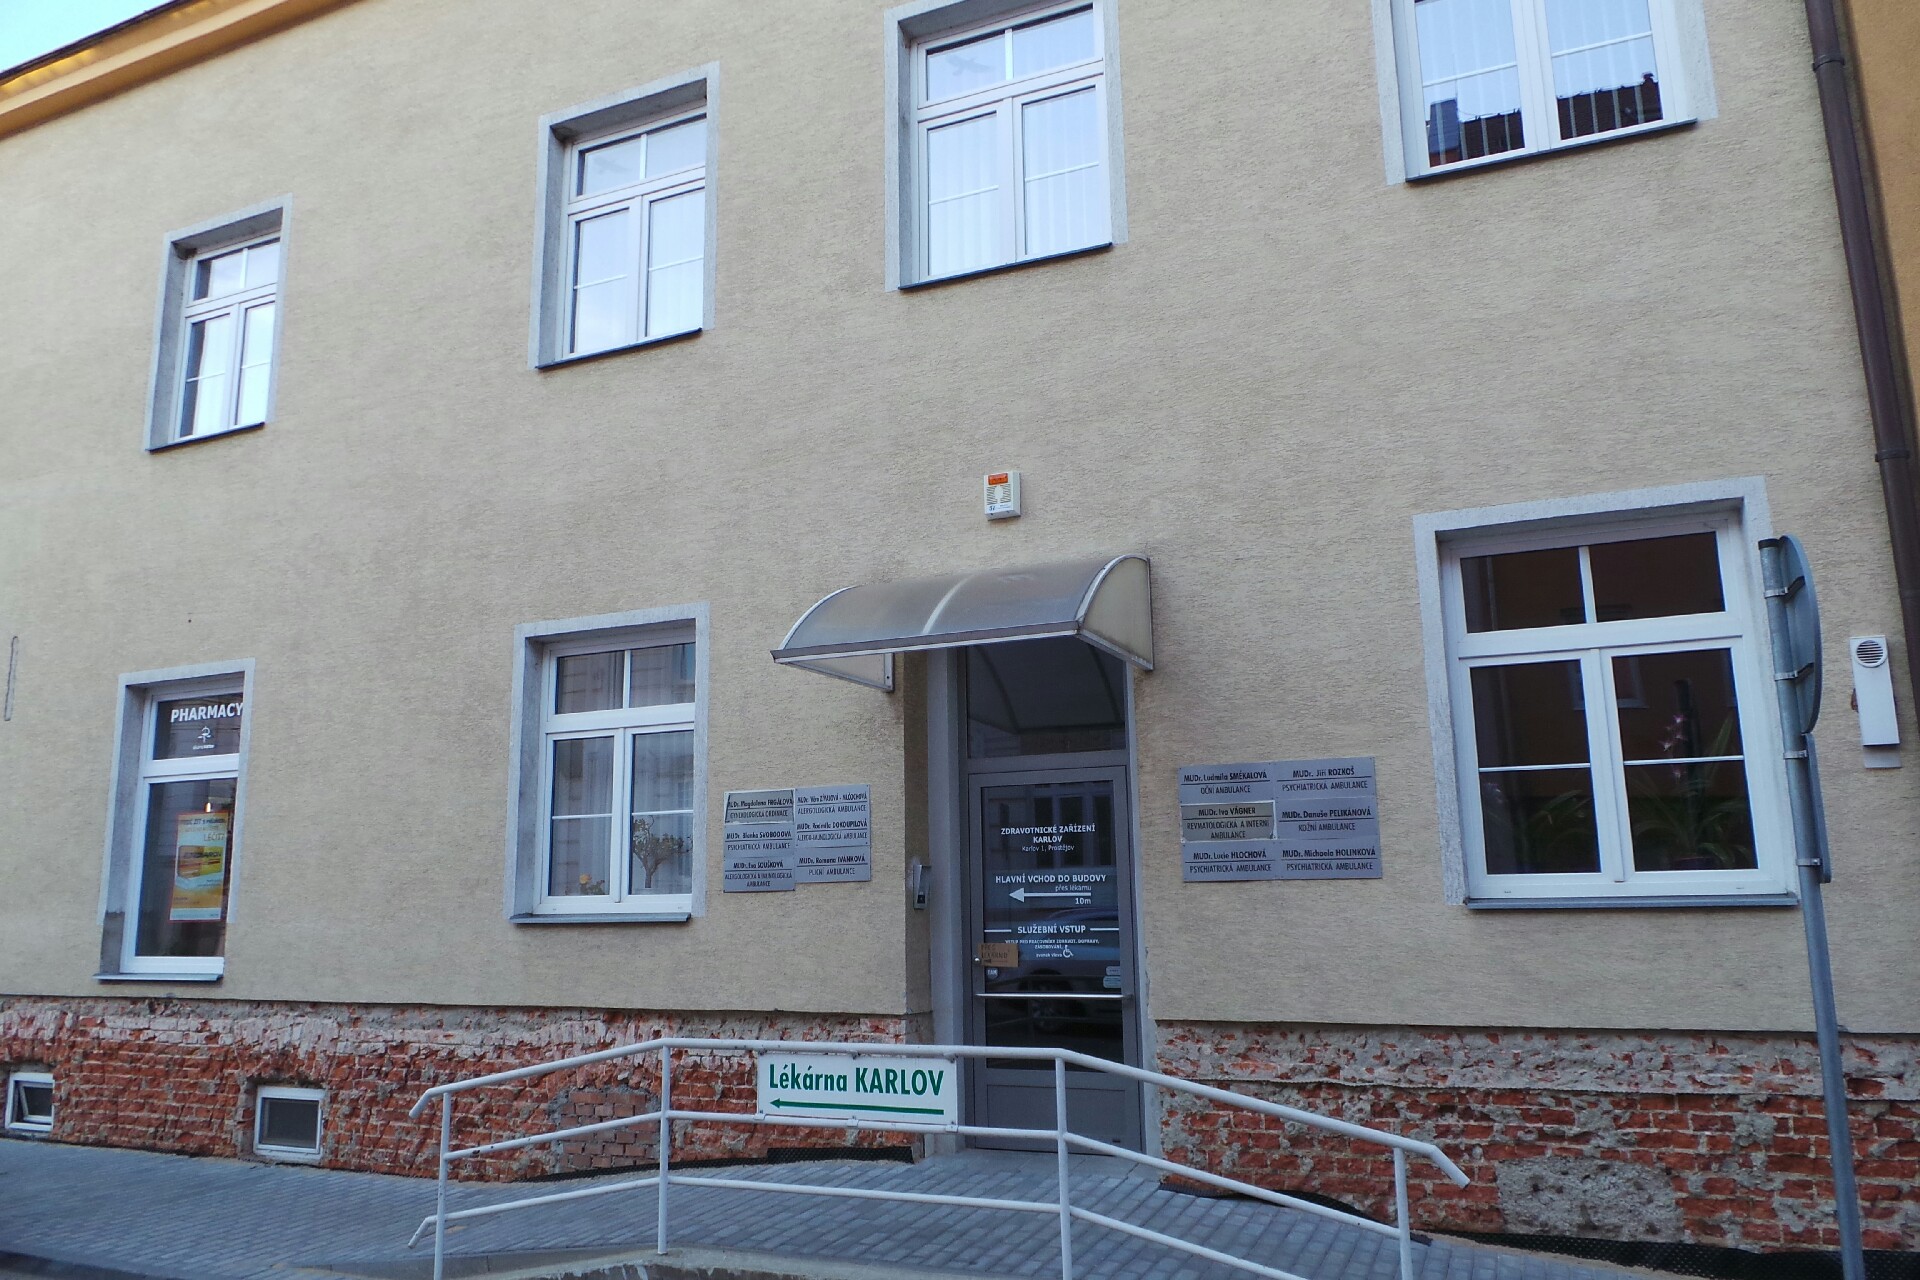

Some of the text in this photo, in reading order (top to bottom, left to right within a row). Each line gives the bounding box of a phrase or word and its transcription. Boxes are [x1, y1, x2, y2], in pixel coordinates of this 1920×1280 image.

[170, 702, 243, 723] PHARMACY
[1292, 765, 1355, 778] MUDr. Jiří ROZKOŠ
[1184, 774, 1204, 782] MUDr.
[1204, 772, 1228, 781] Ludmila
[1200, 785, 1251, 795] OČNÍ AMBULANCE
[1282, 780, 1368, 792] PSYCHIATRICKÁ AMBULANCE
[798, 804, 866, 815] ALERGOLOGICKÁ AMBULANCE
[1199, 805, 1256, 817] MUDr. Ivo VÁGNER
[1282, 805, 1372, 819] MUDr. Danuše PELIKÁNOVÁ
[832, 818, 868, 828] DOKOUPILOVÁ
[1187, 821, 1238, 830] REVMATOLOGICKÁ
[1298, 822, 1356, 832] KOŽNÍ AMBULANCE
[1000, 823, 1096, 835] ZDRAVOTNICKÉ ZAŘÍZENÍ
[742, 831, 759, 839] Blanka
[1033, 835, 1063, 844] KARLOV
[1210, 831, 1246, 839] AMBULANCE
[727, 842, 791, 851] PSYCHIATRICKÁ AMBULANCE
[1048, 844, 1075, 853] Prostějov
[1193, 848, 1267, 860] MUDr. Lucie HLOCHOVÁ
[1282, 846, 1376, 858] MUDr. Michaela HOLINKOVÁ
[815, 856, 837, 864] Romana
[1190, 863, 1272, 874] PSYCHIATRICKÁ AMBULANCE
[1286, 861, 1374, 871] PSYCHIATRICKÁ AMBULANCE
[826, 867, 856, 876] AMBULANCE
[995, 873, 1107, 884] HLAVNÍ VCHOD DO BUDOVY
[1075, 897, 1092, 905] 10m
[1017, 923, 1086, 934] SLUŽEBNÍ VSTUP
[769, 1063, 944, 1096] Lékárna KARLOV
